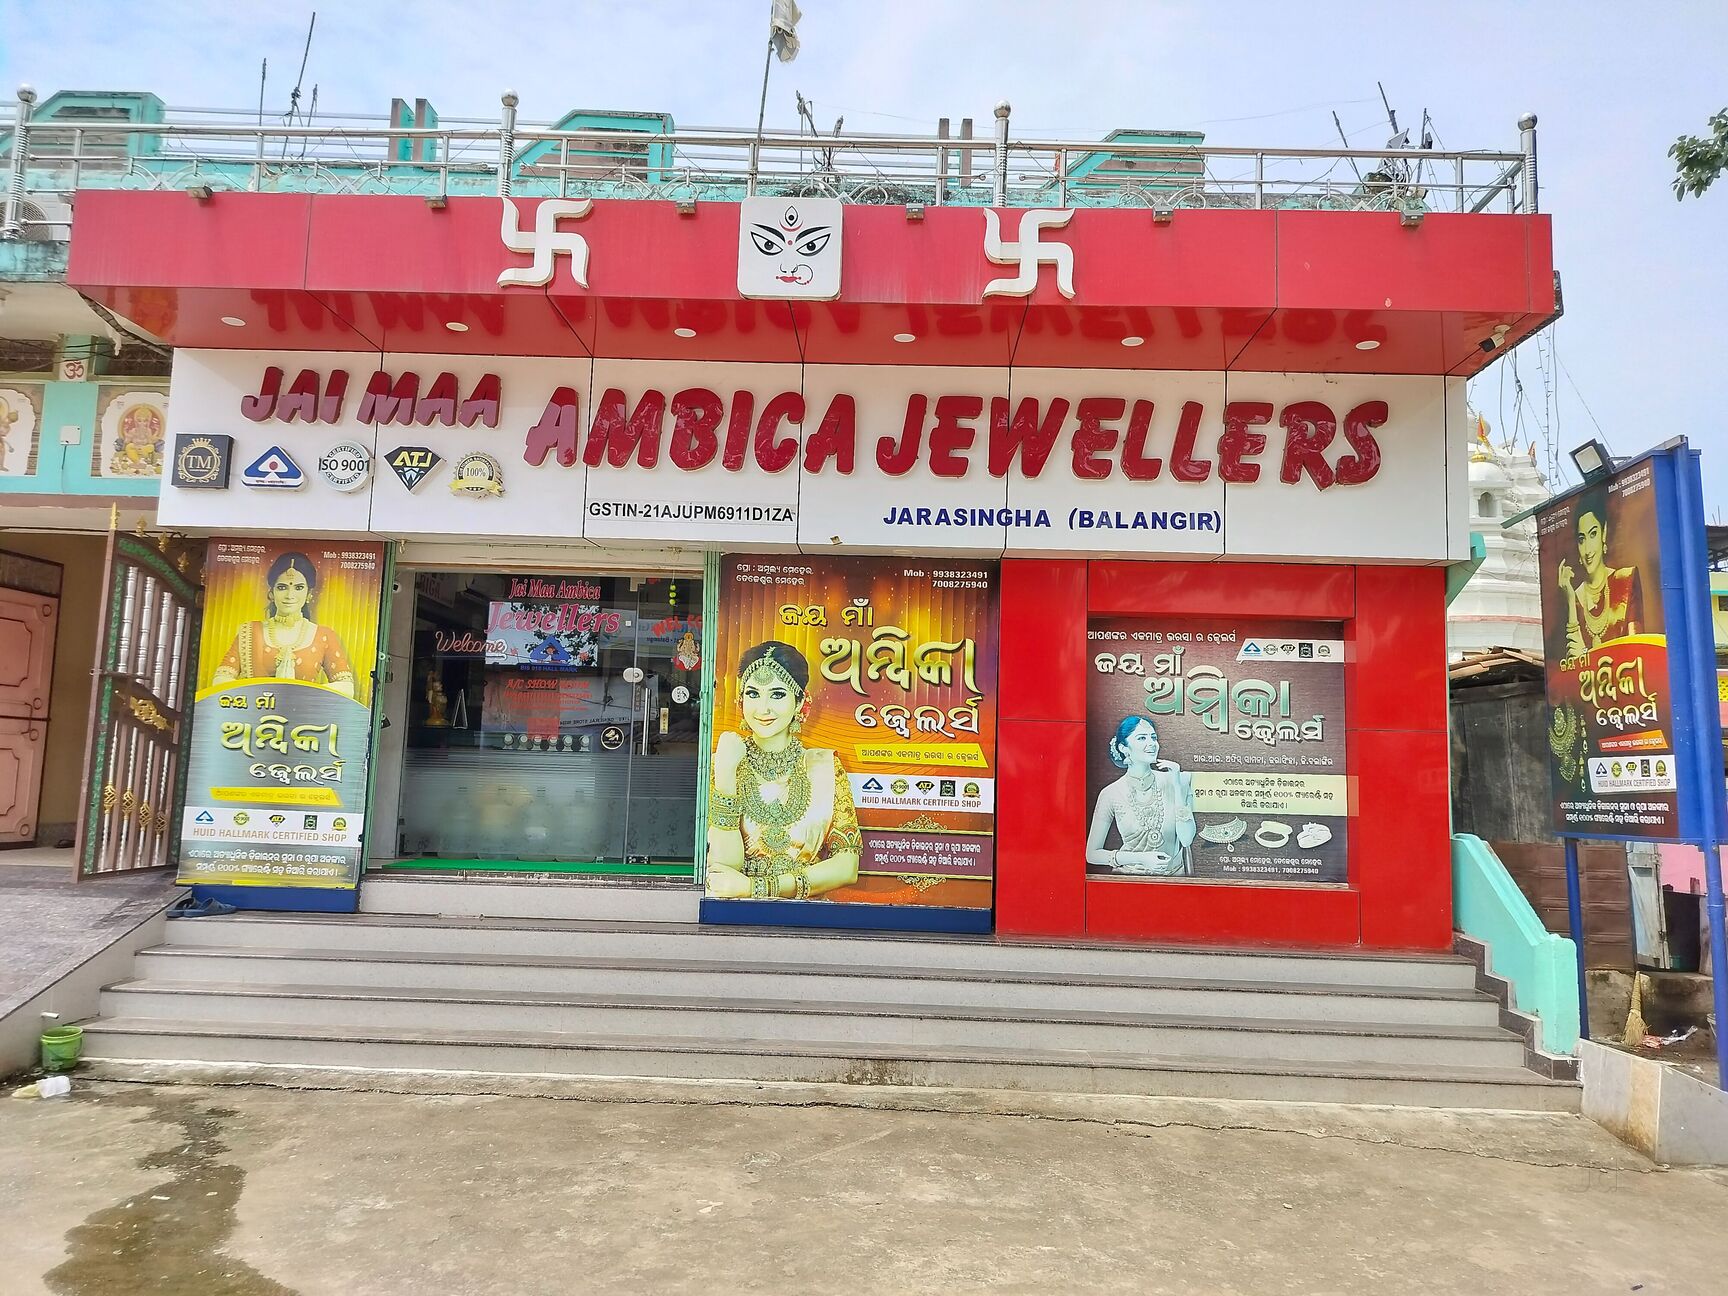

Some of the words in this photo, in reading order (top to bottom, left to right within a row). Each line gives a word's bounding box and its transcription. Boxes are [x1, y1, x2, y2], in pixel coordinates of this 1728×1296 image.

[241, 366, 349, 426] JAI
[358, 370, 502, 429] MAA
[524, 386, 856, 476] AMBICA
[875, 394, 1388, 489] JEWELLERS
[187, 454, 213, 470] TM
[318, 458, 338, 472] ISO
[341, 459, 370, 473] 9001
[466, 467, 487, 477] 100%
[589, 501, 794, 522] GSTIN-21AJUPM6911D1ZA
[884, 507, 1051, 529] JARASINGHA
[1068, 508, 1222, 533] (BALANGIR)
[341, 551, 376, 560] 9938323491
[340, 561, 375, 570] 7008275940
[904, 569, 924, 578] Mob
[933, 570, 988, 579] 9938323491
[509, 578, 528, 599] Jai
[528, 579, 555, 598] Maa
[556, 580, 601, 600] Ambica
[932, 580, 988, 589] 7008275940
[484, 602, 621, 633] Jewellers
[778, 603, 828, 627] ଜୟ
[435, 630, 505, 654] Welcome
[1094, 652, 1145, 675] ଜୟ
[862, 796, 879, 804] HUID
[881, 797, 921, 805] HALLMARK
[923, 798, 960, 807] CERTIFIED
[961, 800, 981, 808] SHOP
[193, 828, 216, 837] HUID
[219, 829, 269, 839] HALLMARK
[272, 831, 319, 841] CERTIFIED
[321, 834, 347, 842] SHOP
